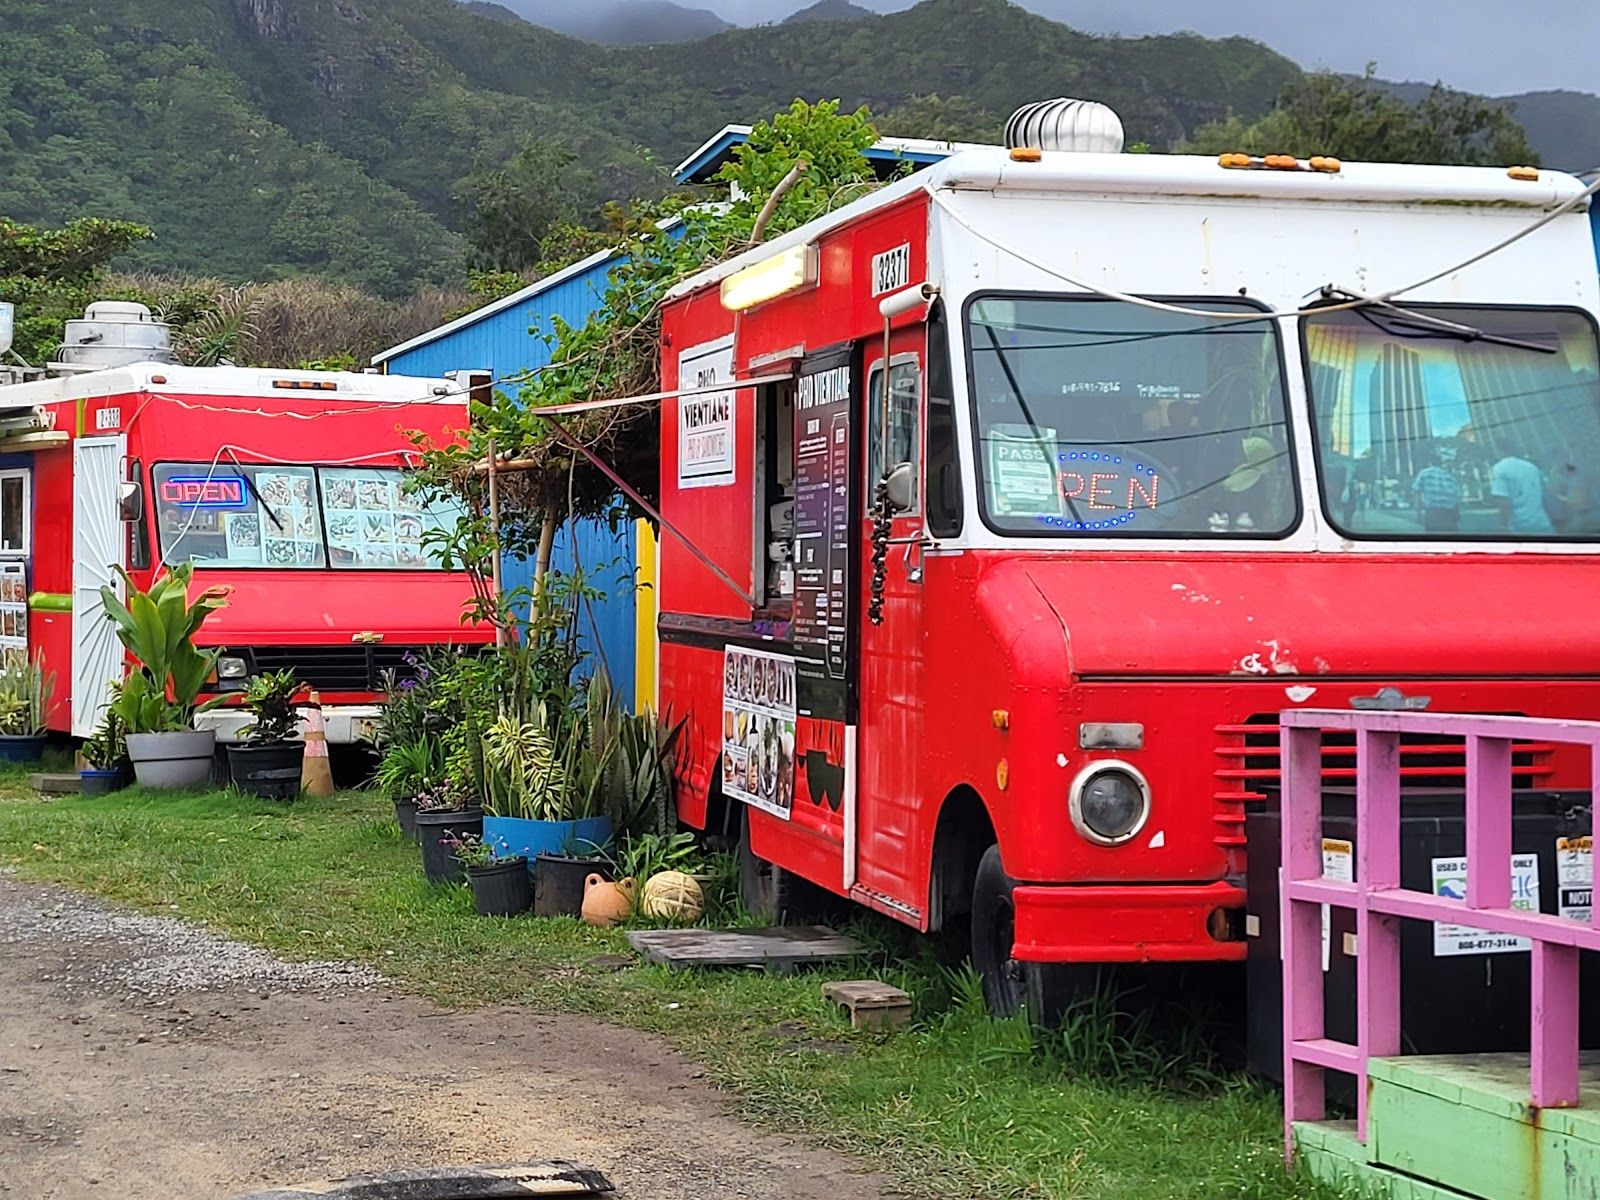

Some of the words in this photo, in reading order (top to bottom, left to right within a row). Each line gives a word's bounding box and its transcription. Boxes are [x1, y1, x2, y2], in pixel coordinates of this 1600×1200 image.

[879, 246, 908, 292] 32371
[798, 375, 814, 410] PHO
[684, 396, 729, 428] VIENTIANE
[998, 446, 1046, 461] PASS
[161, 482, 240, 502] OPEN
[1057, 471, 1159, 510] PEN
[1436, 863, 1457, 872] USED
[1513, 860, 1533, 868] ONLY
[1568, 891, 1592, 905] NOT
